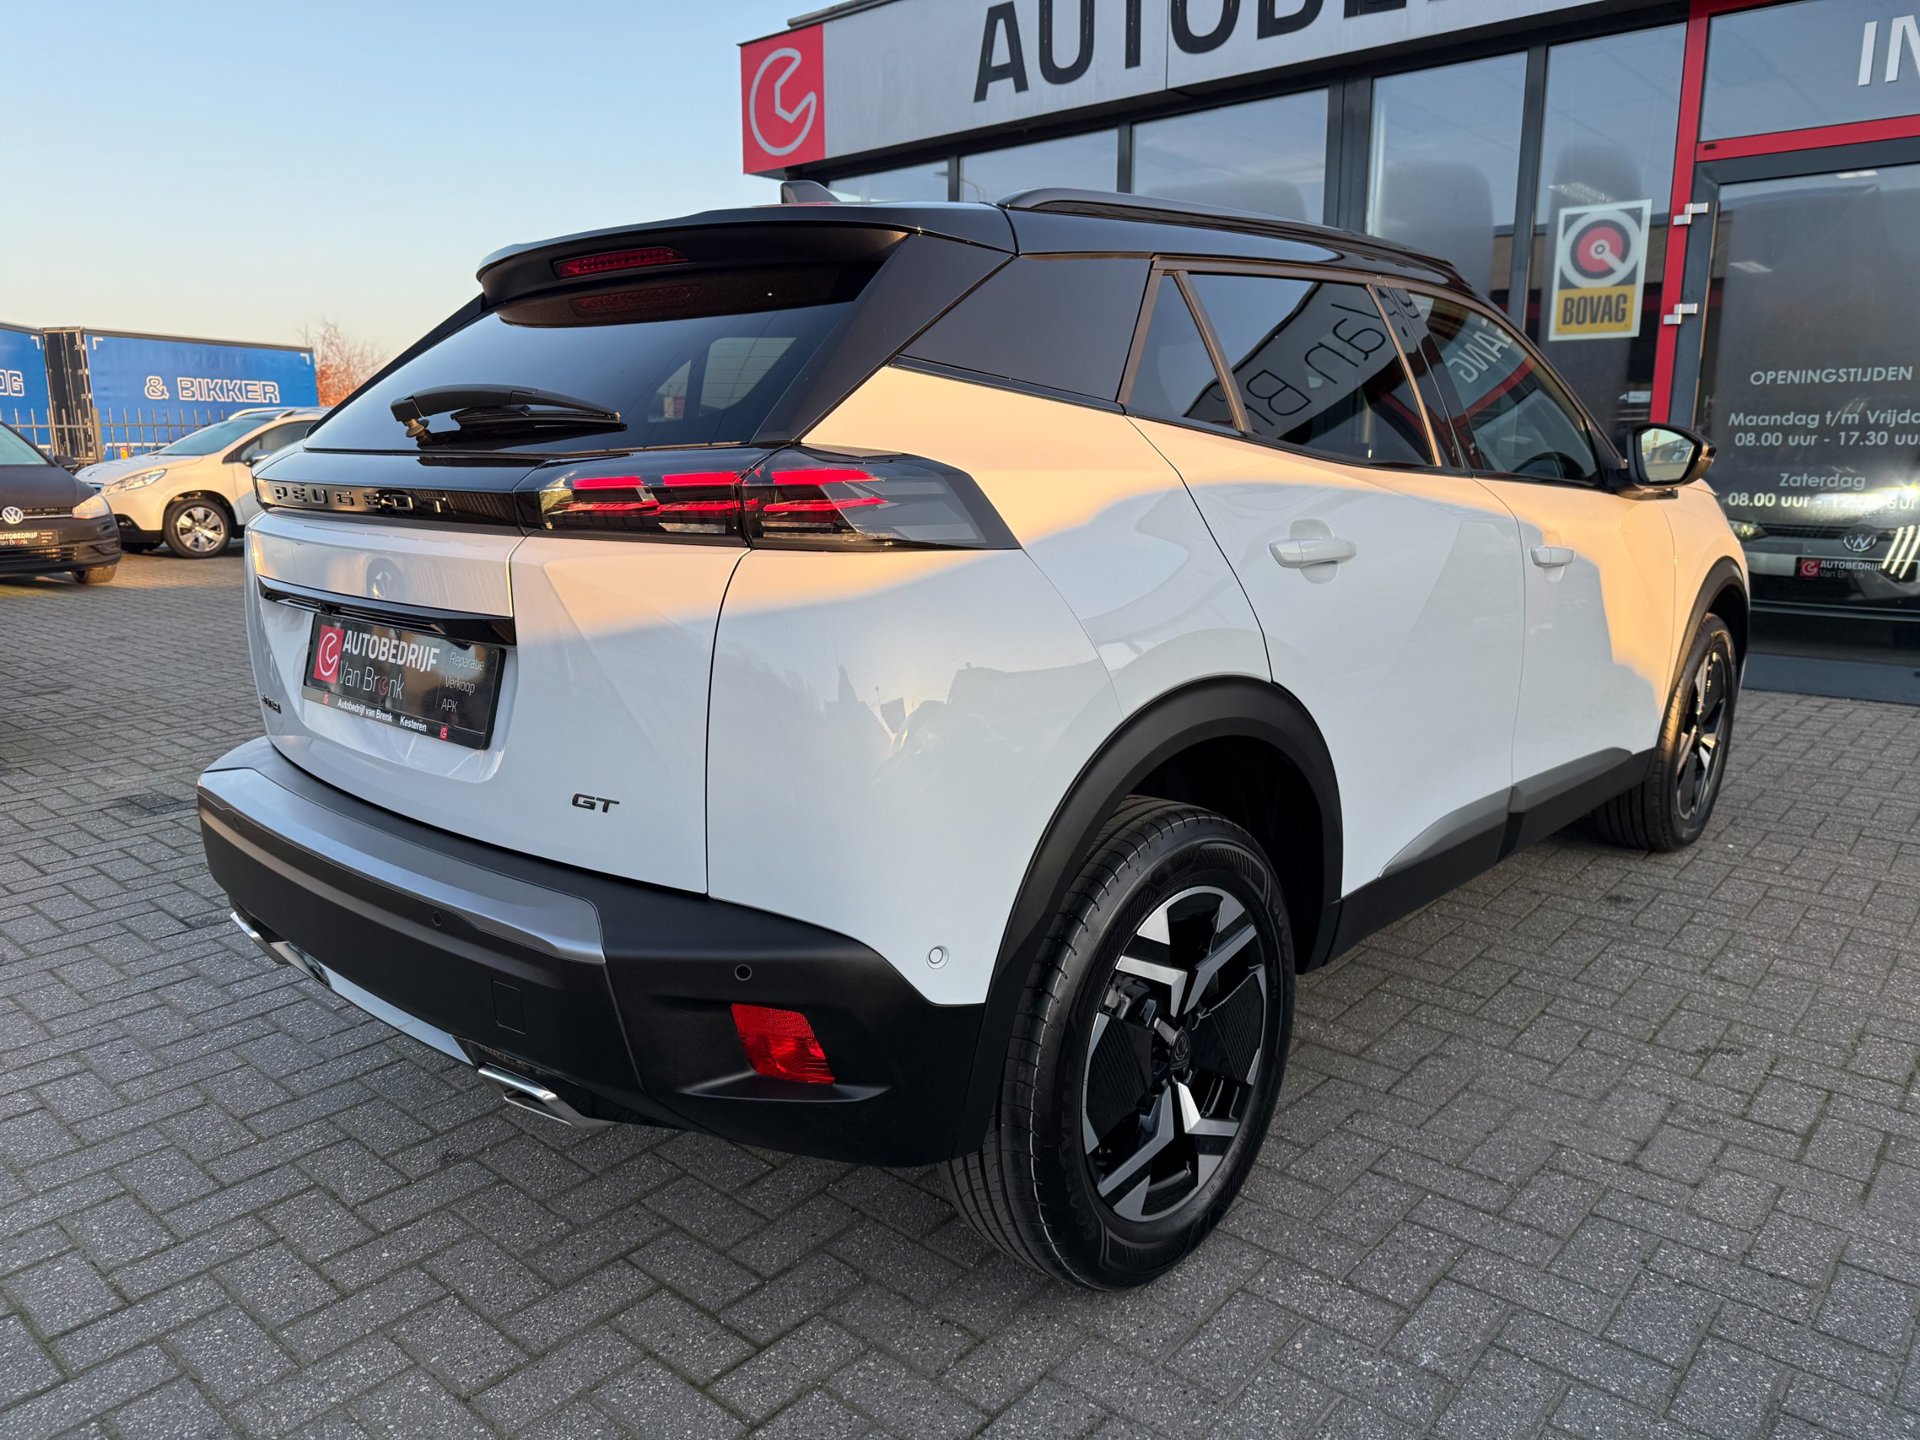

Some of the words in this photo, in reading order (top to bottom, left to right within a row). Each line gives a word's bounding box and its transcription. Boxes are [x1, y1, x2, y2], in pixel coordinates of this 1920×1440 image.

[1562, 293, 1628, 325] BOVAG
[1750, 366, 1913, 385] OPENINGSTIJDEN
[145, 375, 170, 400] &
[177, 376, 280, 404] BIKKER
[1728, 411, 1820, 429] Maandag
[1825, 410, 1859, 427] t/m
[1734, 432, 1783, 446] 08.00
[1788, 434, 1818, 446] uur
[1839, 431, 1889, 446] 17.30
[1894, 433, 1920, 446] uu
[1779, 473, 1866, 491] Zaterdag
[274, 485, 447, 513] PEUGEOT
[1728, 492, 1776, 507] 08.00
[1781, 494, 1811, 508] uur
[342, 630, 440, 672] AUTOBEDRIJF
[449, 651, 485, 671] Reparatie
[339, 660, 360, 688] Van
[445, 675, 476, 696] Verkoop
[337, 698, 366, 716] Autobedrijf
[365, 706, 376, 718] van
[375, 709, 393, 722] Brenk
[399, 715, 427, 732] Kesteren
[440, 698, 458, 713] APK
[572, 793, 620, 813] GT
